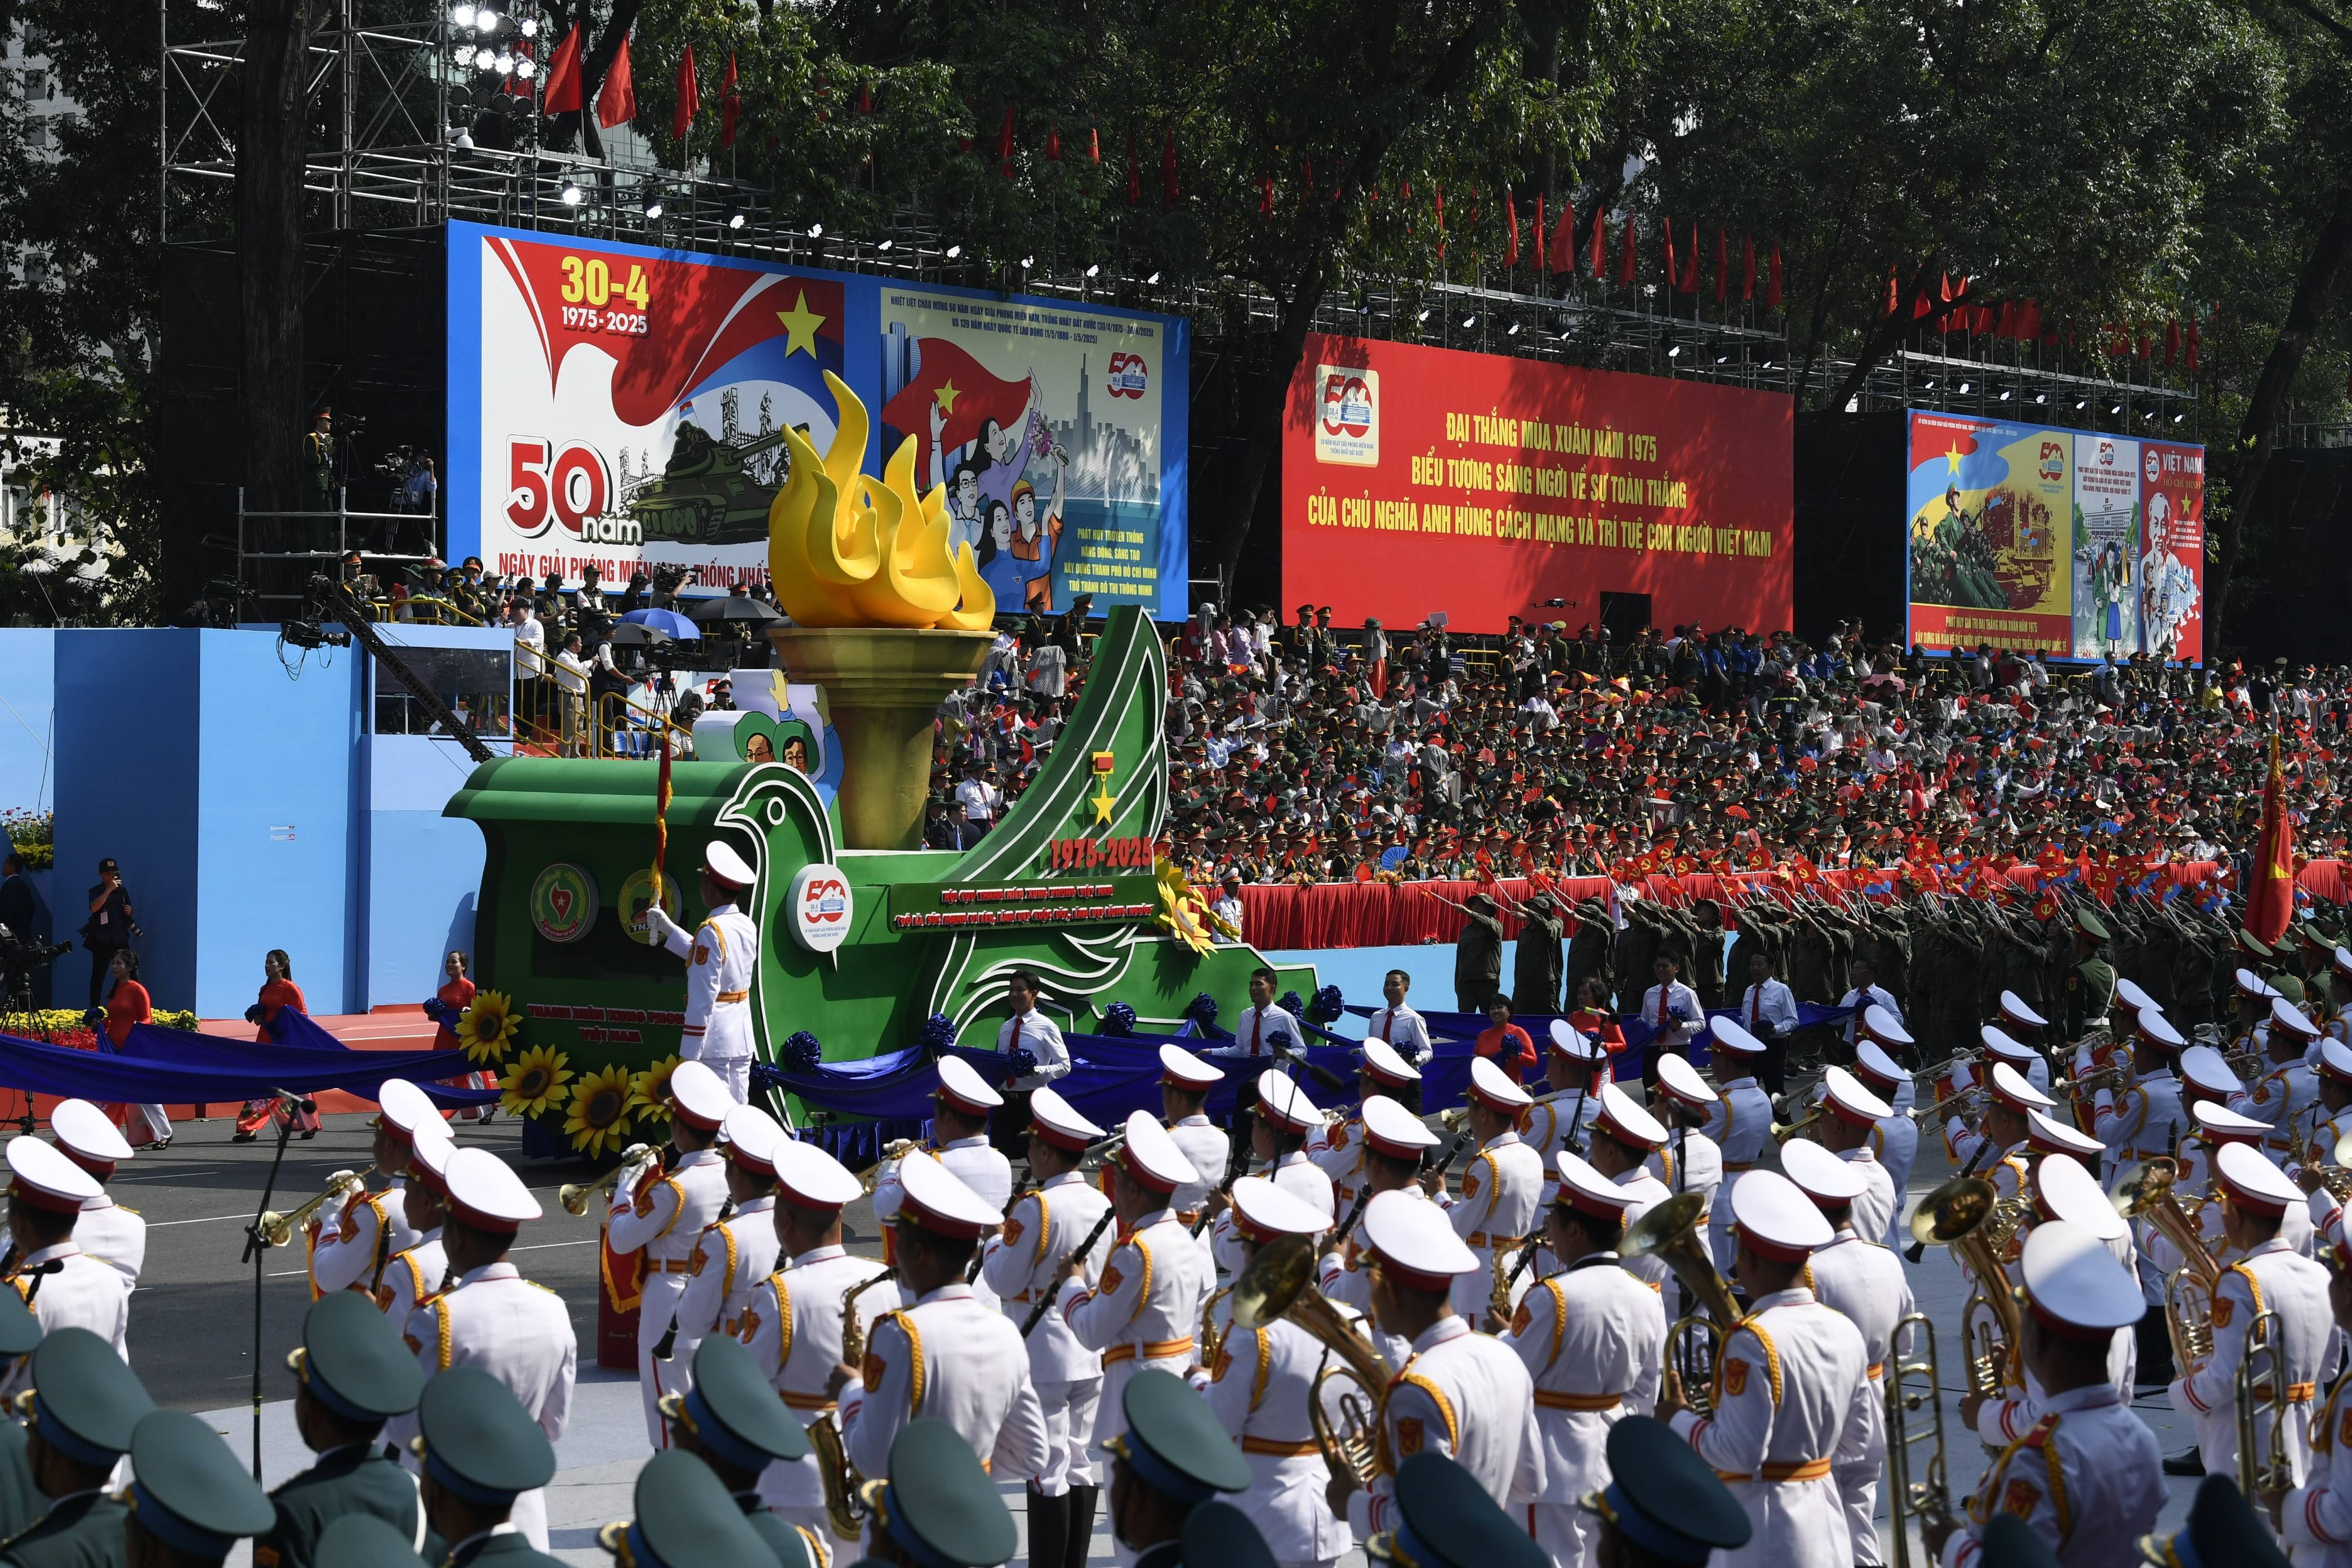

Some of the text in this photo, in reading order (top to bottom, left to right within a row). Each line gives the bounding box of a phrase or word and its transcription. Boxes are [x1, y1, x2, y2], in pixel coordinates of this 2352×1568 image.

[561, 256, 649, 310] 30-4
[562, 306, 647, 333] 1975-2025
[949, 303, 956, 312] 50
[1446, 406, 1657, 462] ĐẠI THẮNG MÙA XUÂN NĂM 1975
[1411, 446, 1687, 508] BIỂU TƯỢNG SÁNG NGỜI VỀ SỰ TOÀN THẮNG
[2163, 450, 2181, 475] VIỆT
[2184, 456, 2202, 474] NAM
[505, 439, 608, 535] 50
[2173, 477, 2184, 488] CHÍ
[2186, 480, 2200, 489] MINH
[581, 511, 644, 544] năm
[1308, 486, 1771, 560] CỦA CHỦ NGHĨA ANH HÙNG CÁCH MẠNG VÀ TRÍ TUỆ CON NGƯỜI VIỆT NAM
[499, 549, 535, 578] NGÀY
[540, 549, 565, 579] GIẢI
[693, 557, 734, 587] THỐNG
[1143, 568, 1157, 579] MINH
[1138, 585, 1152, 596] MINH
[2029, 622, 2037, 633] 1975
[1050, 836, 1152, 868] 1975-2025
